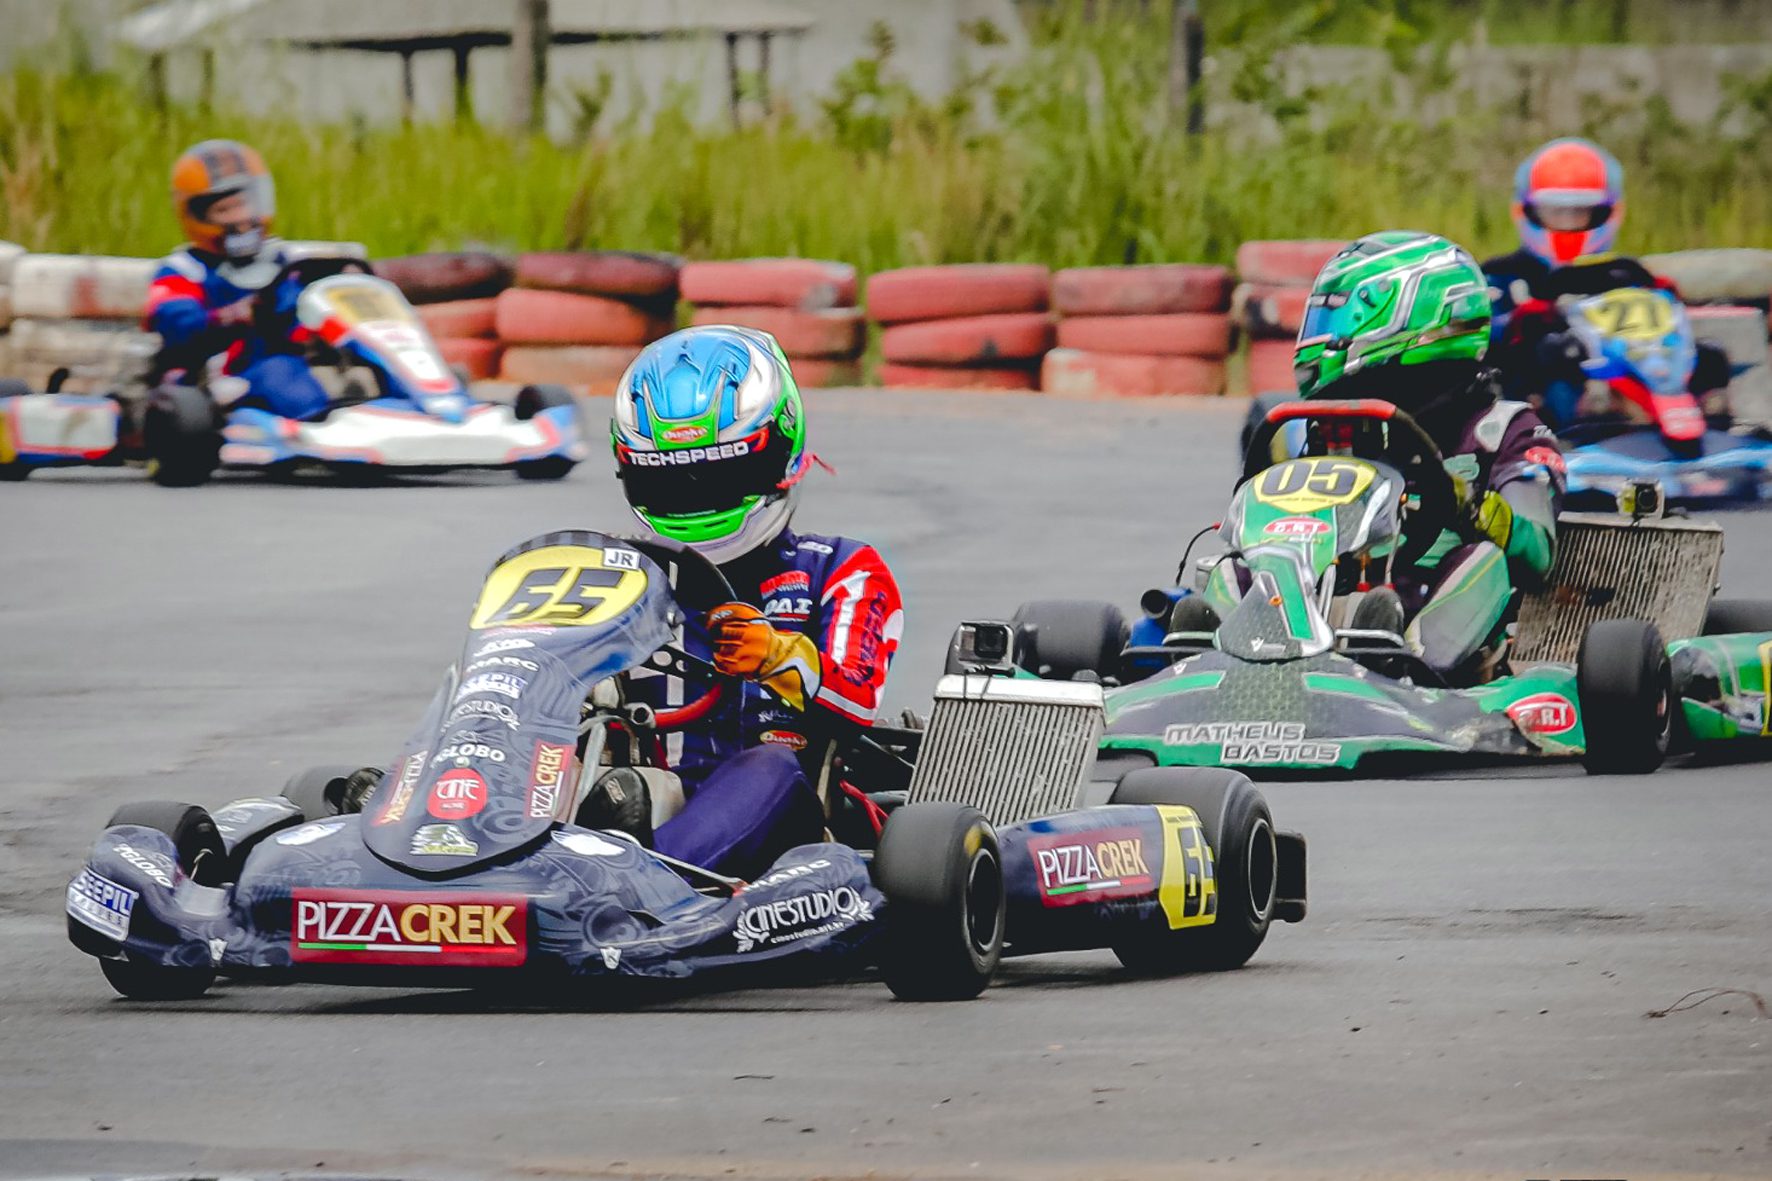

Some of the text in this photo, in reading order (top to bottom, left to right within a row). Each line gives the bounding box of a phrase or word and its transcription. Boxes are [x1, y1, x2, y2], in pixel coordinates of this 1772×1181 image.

[627, 441, 749, 467] TECHSPEED
[1261, 460, 1358, 496] 05
[607, 552, 635, 567] JR
[1164, 722, 1305, 745] MATHEUS
[744, 886, 858, 933] CINESTUDIO
